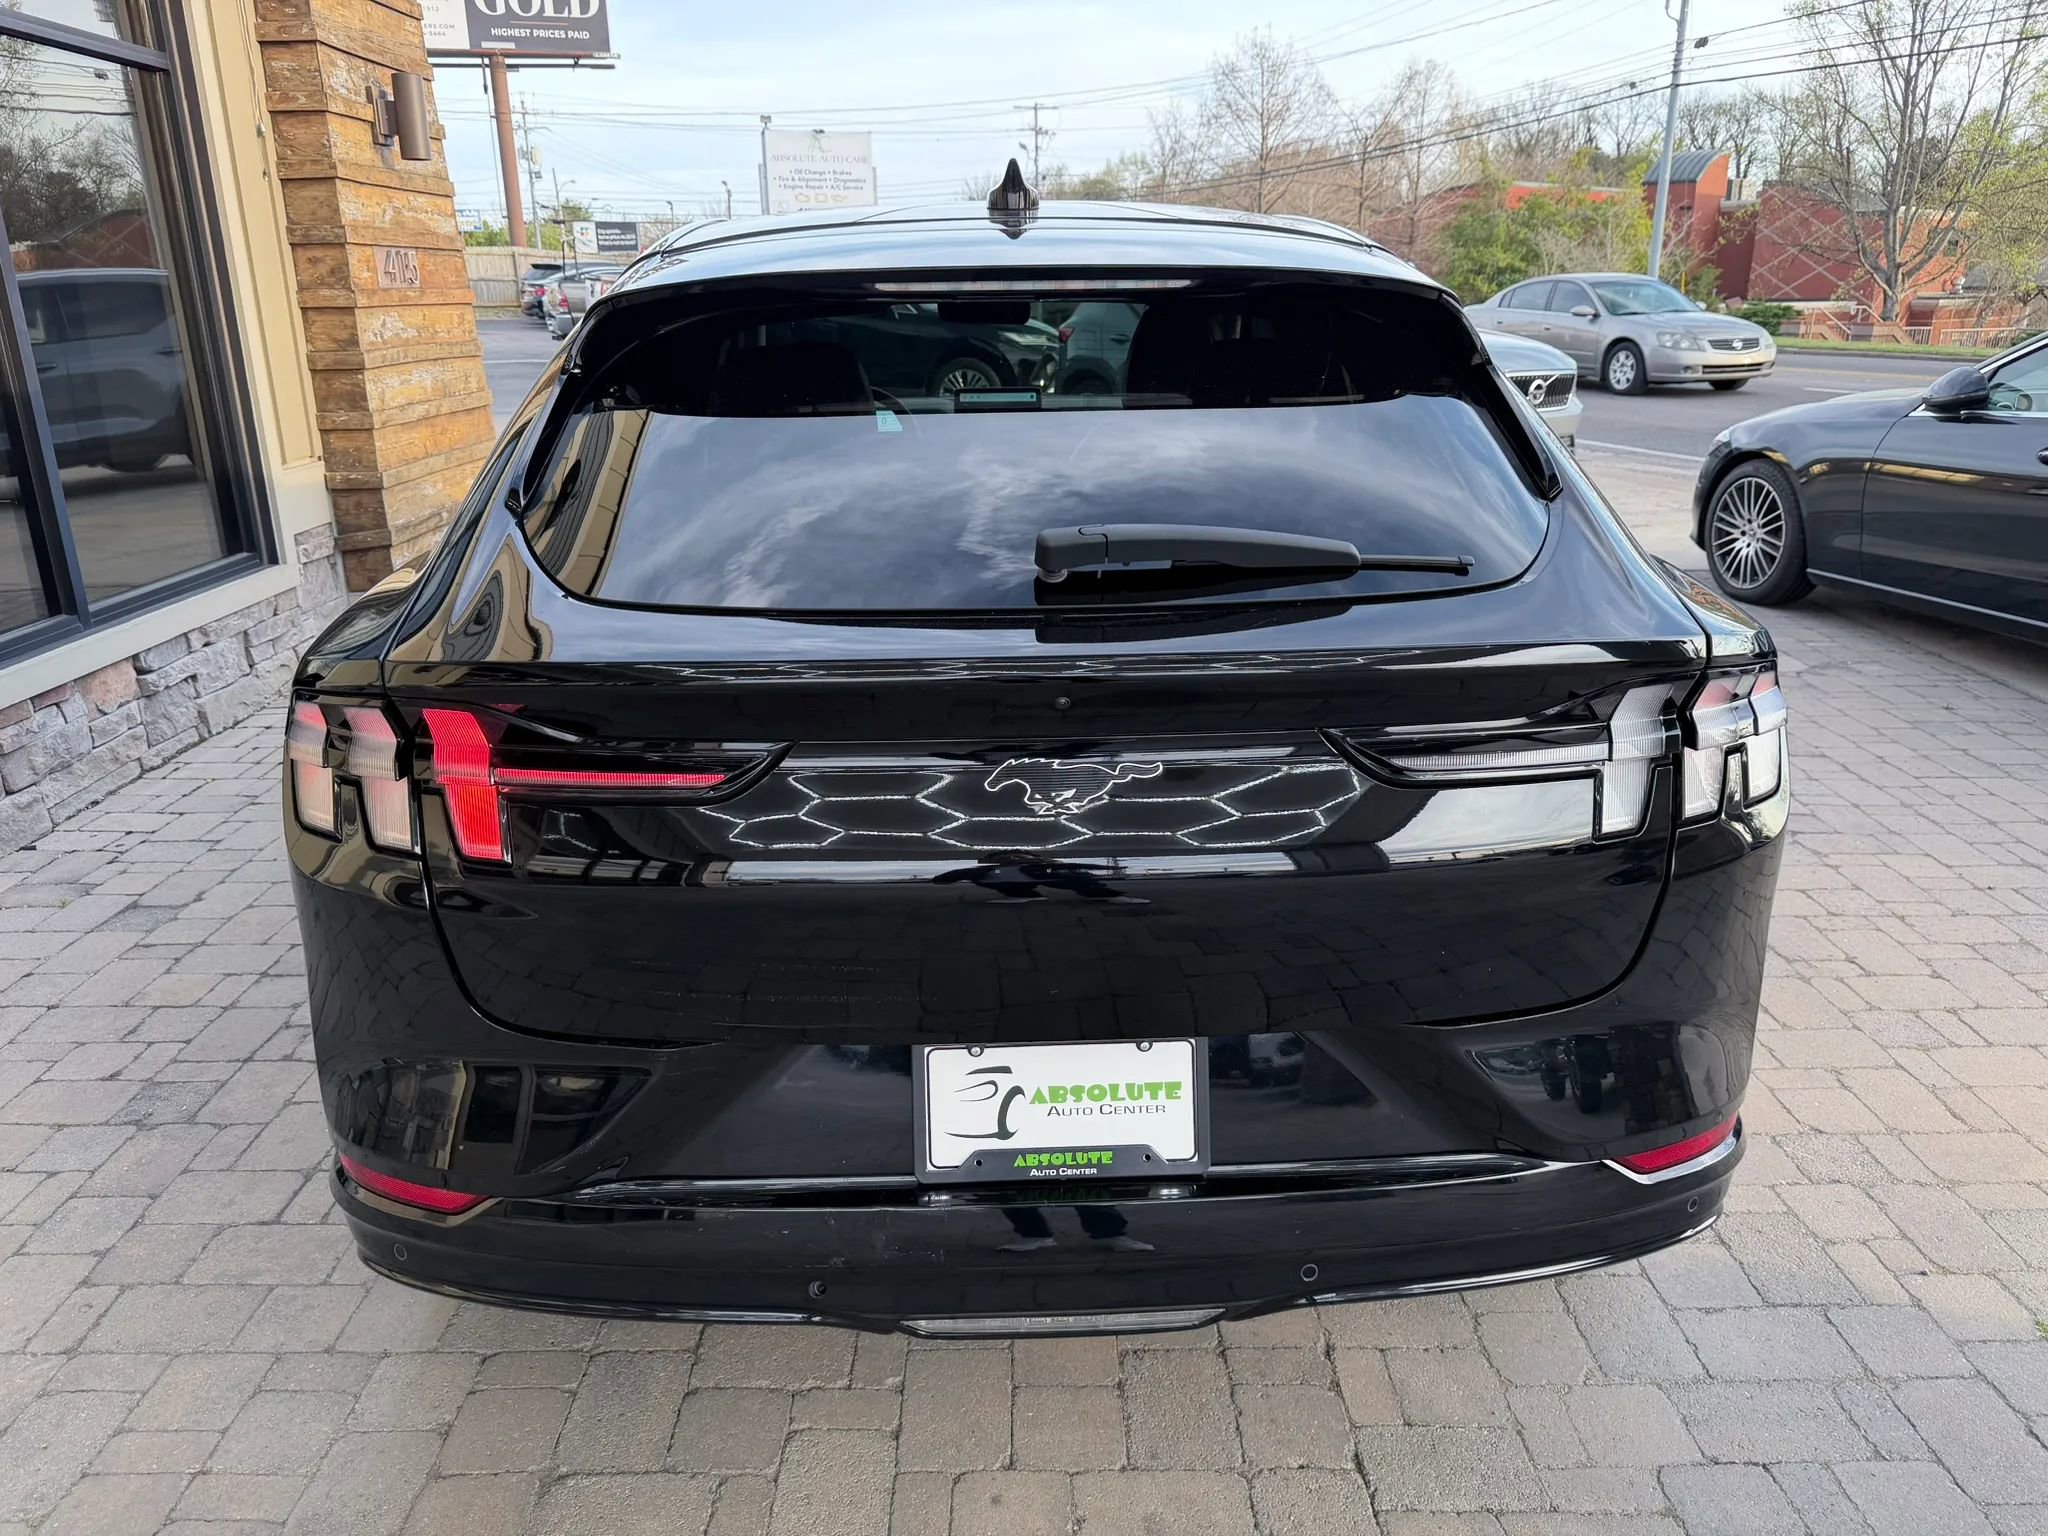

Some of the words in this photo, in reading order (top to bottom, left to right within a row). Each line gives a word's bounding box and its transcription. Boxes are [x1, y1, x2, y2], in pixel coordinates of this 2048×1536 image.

[491, 27, 531, 37] HIGHEST
[533, 29, 566, 39] PRICES
[568, 31, 590, 39] PAID
[1029, 1081, 1182, 1105] ABSOLUTE
[1013, 1151, 1113, 1167] ABSOLUTE
